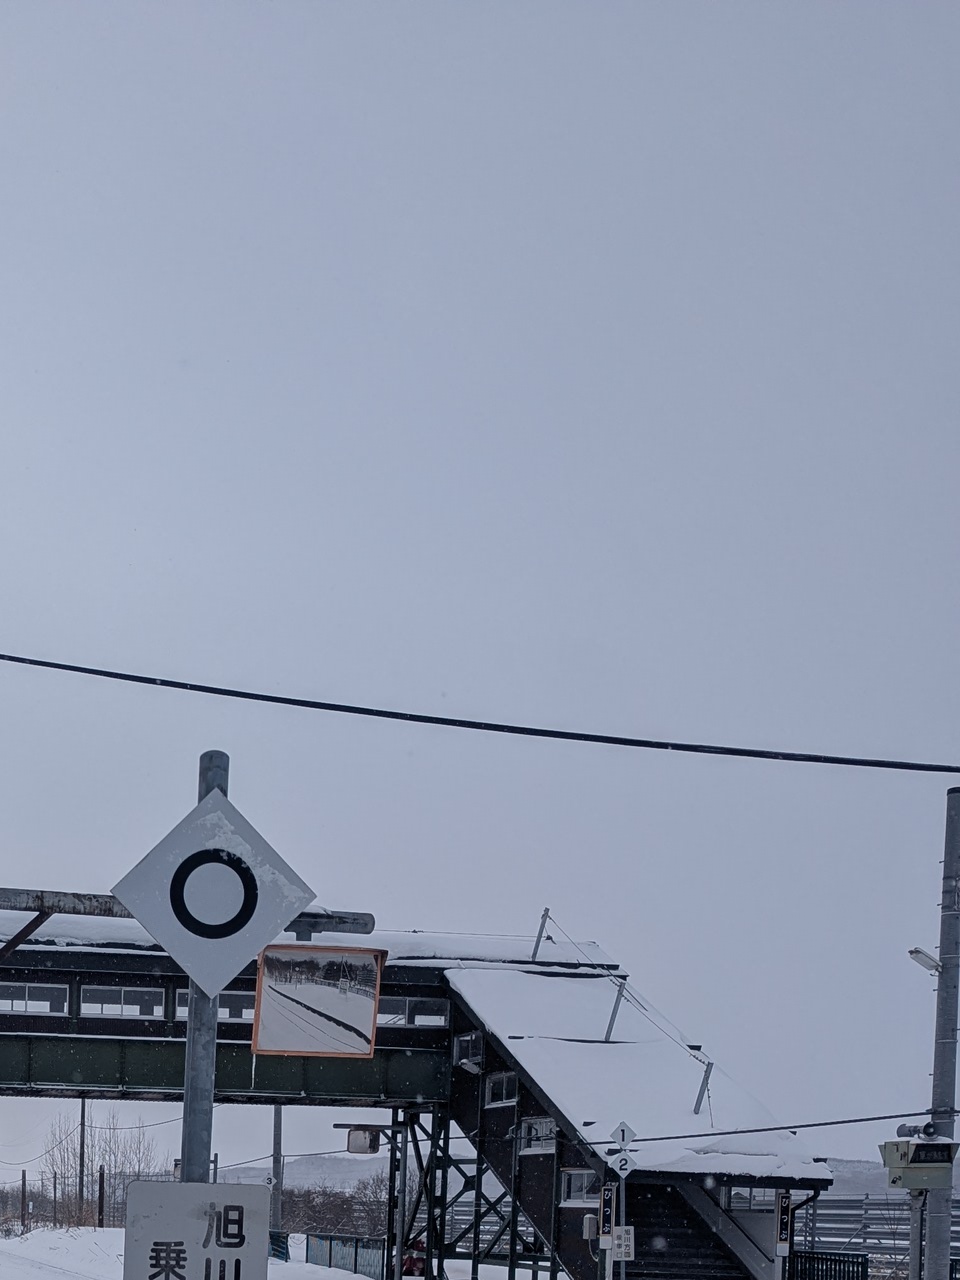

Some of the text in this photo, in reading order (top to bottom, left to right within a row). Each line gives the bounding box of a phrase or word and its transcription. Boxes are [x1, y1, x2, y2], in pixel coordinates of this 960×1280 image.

[620, 1129, 626, 1143] 1
[619, 1158, 629, 1171] 2
[266, 1177, 273, 1185] 3
